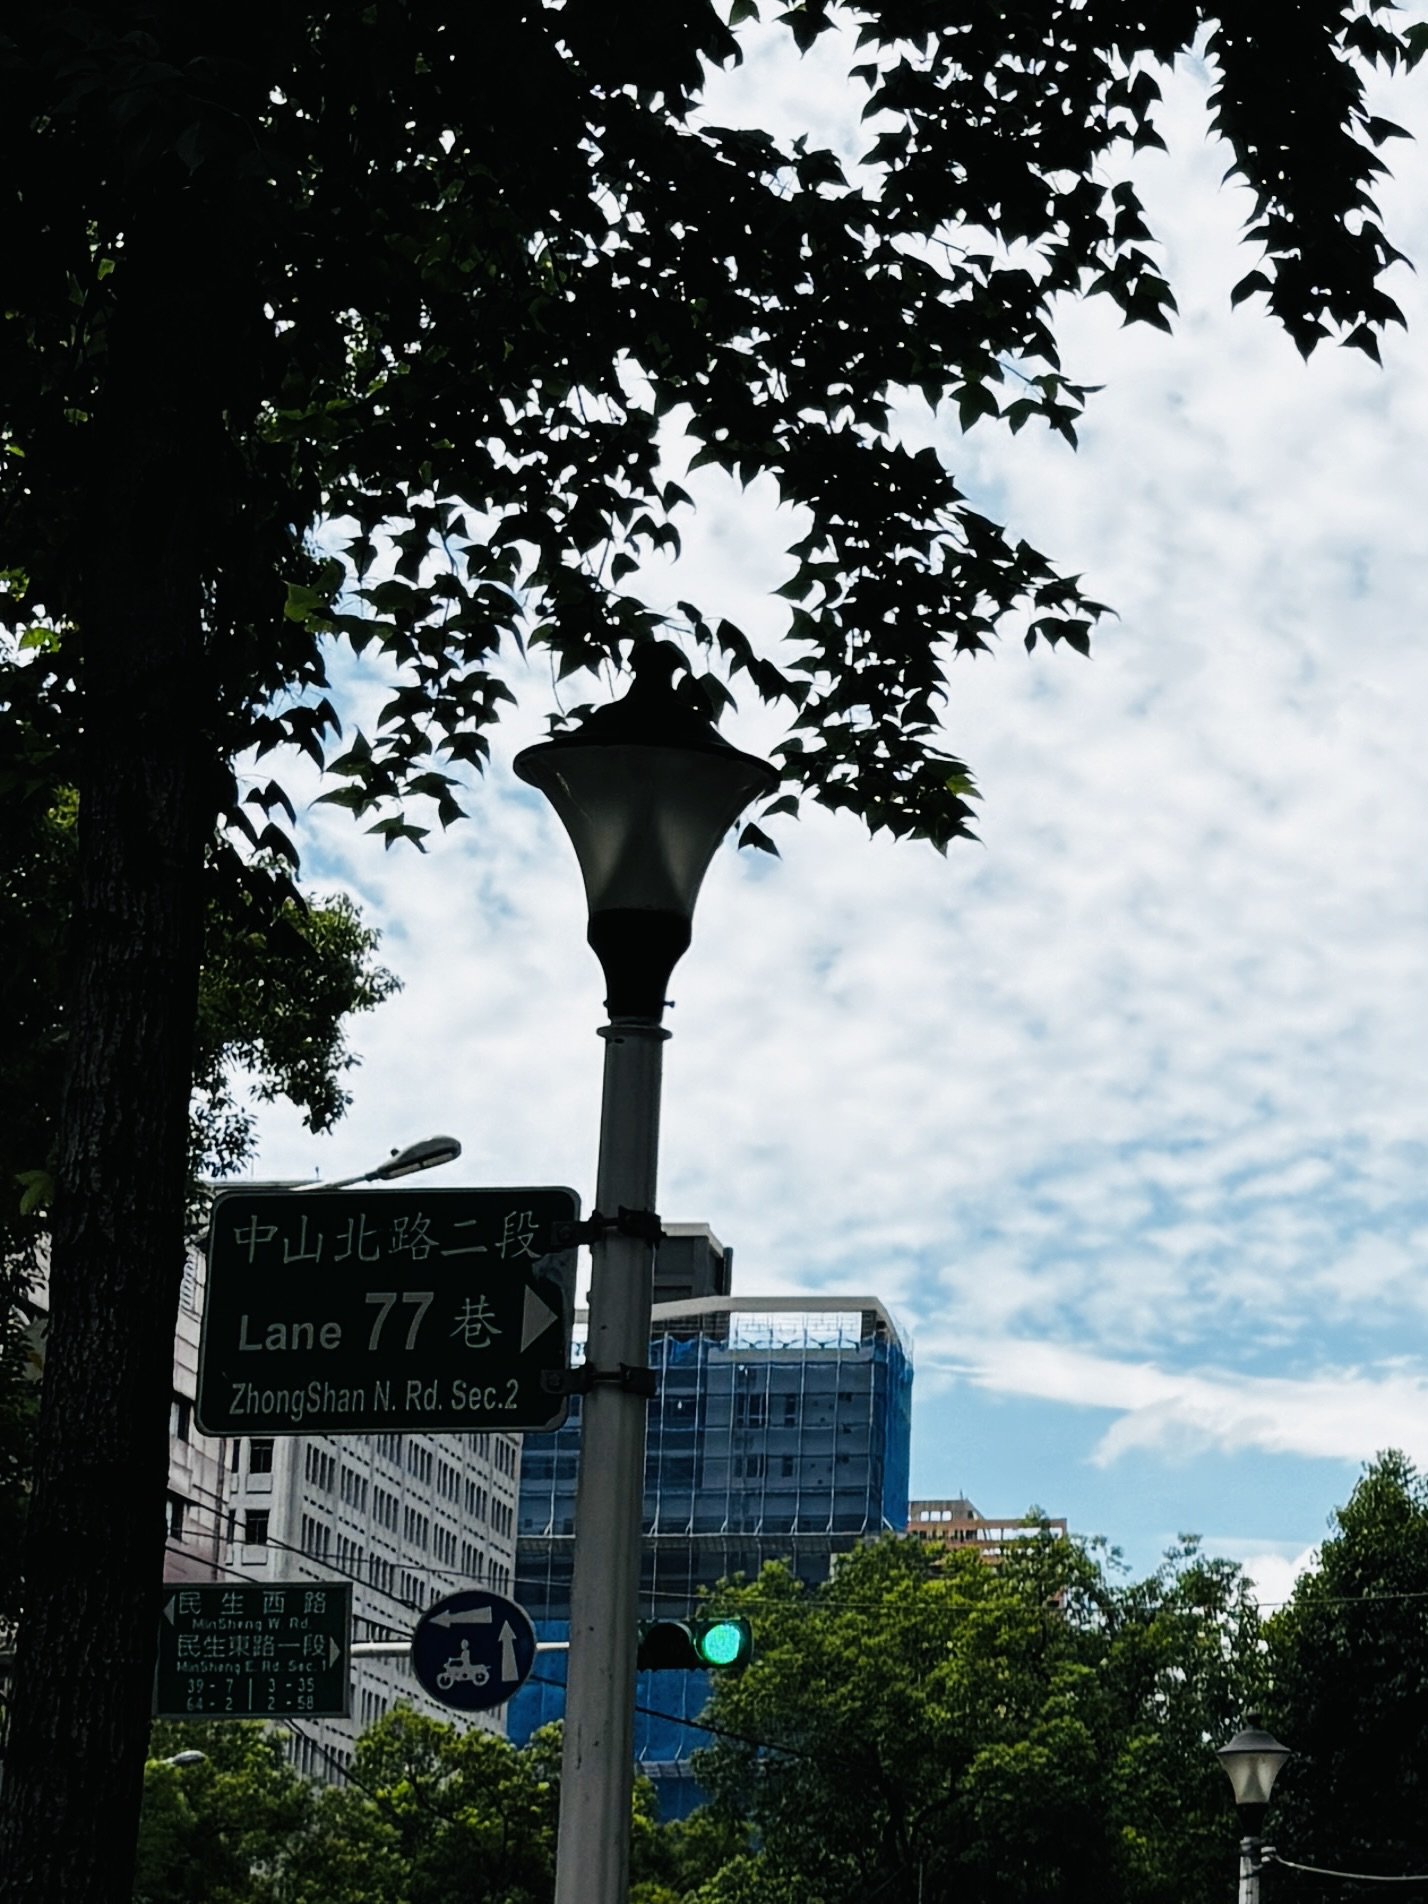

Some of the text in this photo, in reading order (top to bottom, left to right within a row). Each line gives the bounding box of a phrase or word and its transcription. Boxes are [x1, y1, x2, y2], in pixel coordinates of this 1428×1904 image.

[232, 1209, 544, 1265] 中山北路二段
[238, 1291, 503, 1352] Lane 77 巷
[229, 1380, 365, 1423] ZhongShan
[373, 1380, 396, 1413] N.
[405, 1379, 442, 1412] Rd.
[178, 1590, 327, 1615] 民生西路
[177, 1633, 328, 1659] 民生東路一段
